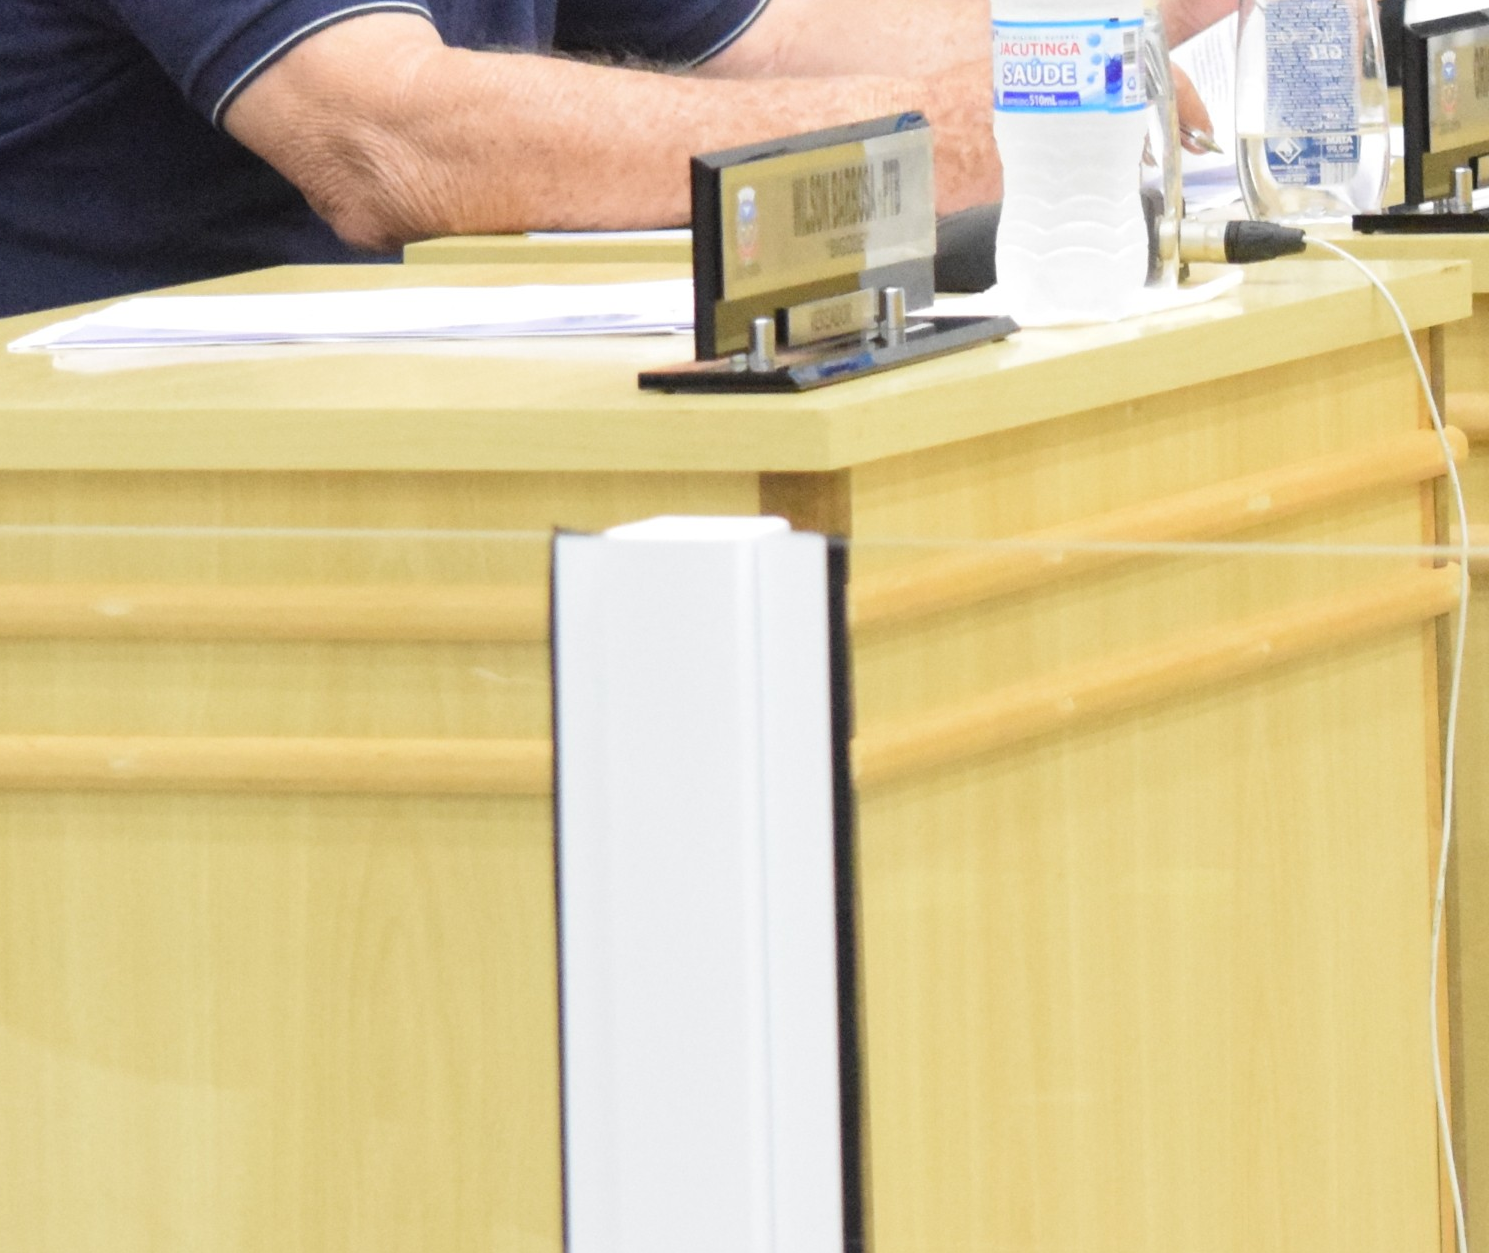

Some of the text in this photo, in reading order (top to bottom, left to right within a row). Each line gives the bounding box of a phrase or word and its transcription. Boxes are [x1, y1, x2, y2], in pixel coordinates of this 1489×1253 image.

[1000, 42, 1081, 57] JACUTINGA
[1003, 58, 1077, 87] SAÚDE
[1029, 93, 1058, 107] 510mL
